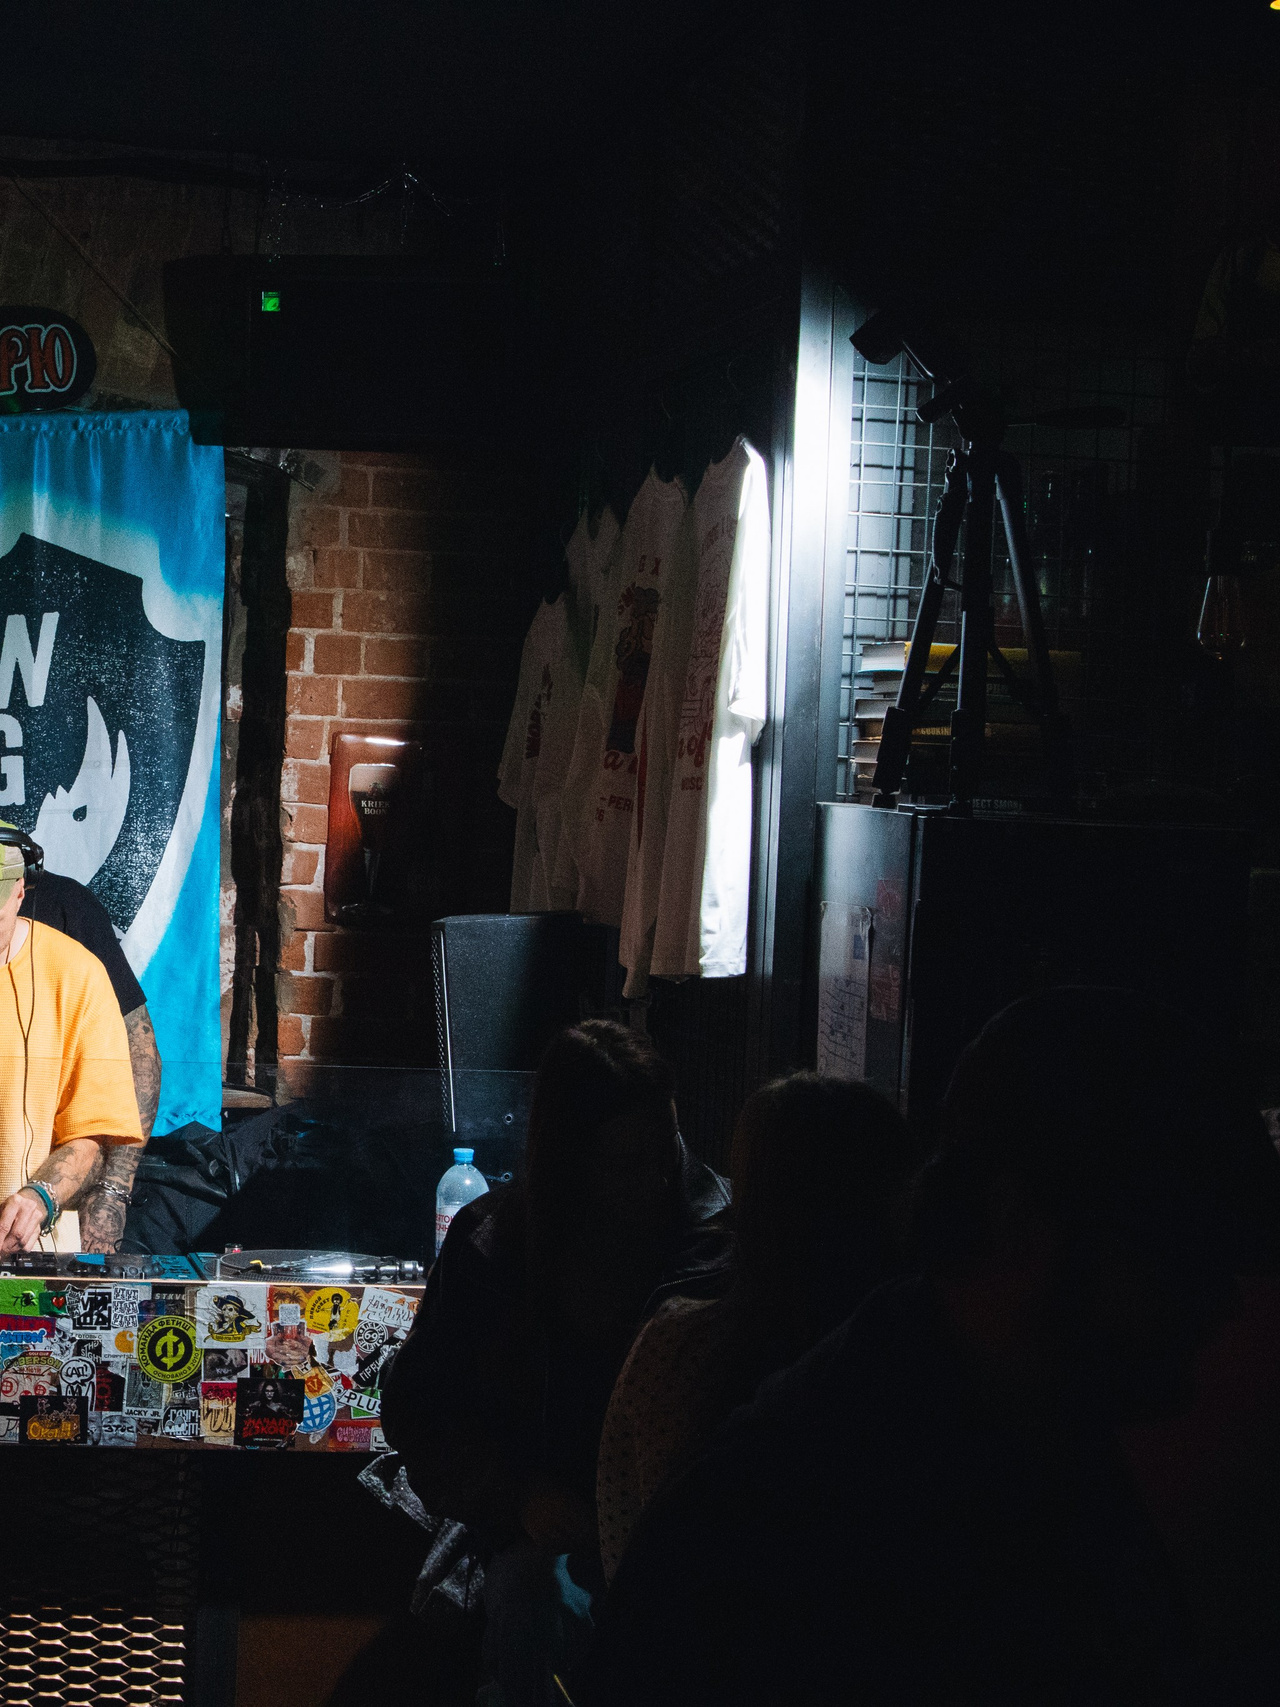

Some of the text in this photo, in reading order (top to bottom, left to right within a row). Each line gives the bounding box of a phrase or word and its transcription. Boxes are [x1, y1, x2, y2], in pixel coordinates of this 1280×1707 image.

[138, 1319, 191, 1366] КОМАНДА ФЕТИШ
[152, 1367, 187, 1379] ОСНОВАНО
[125, 1409, 148, 1417] JACKY
